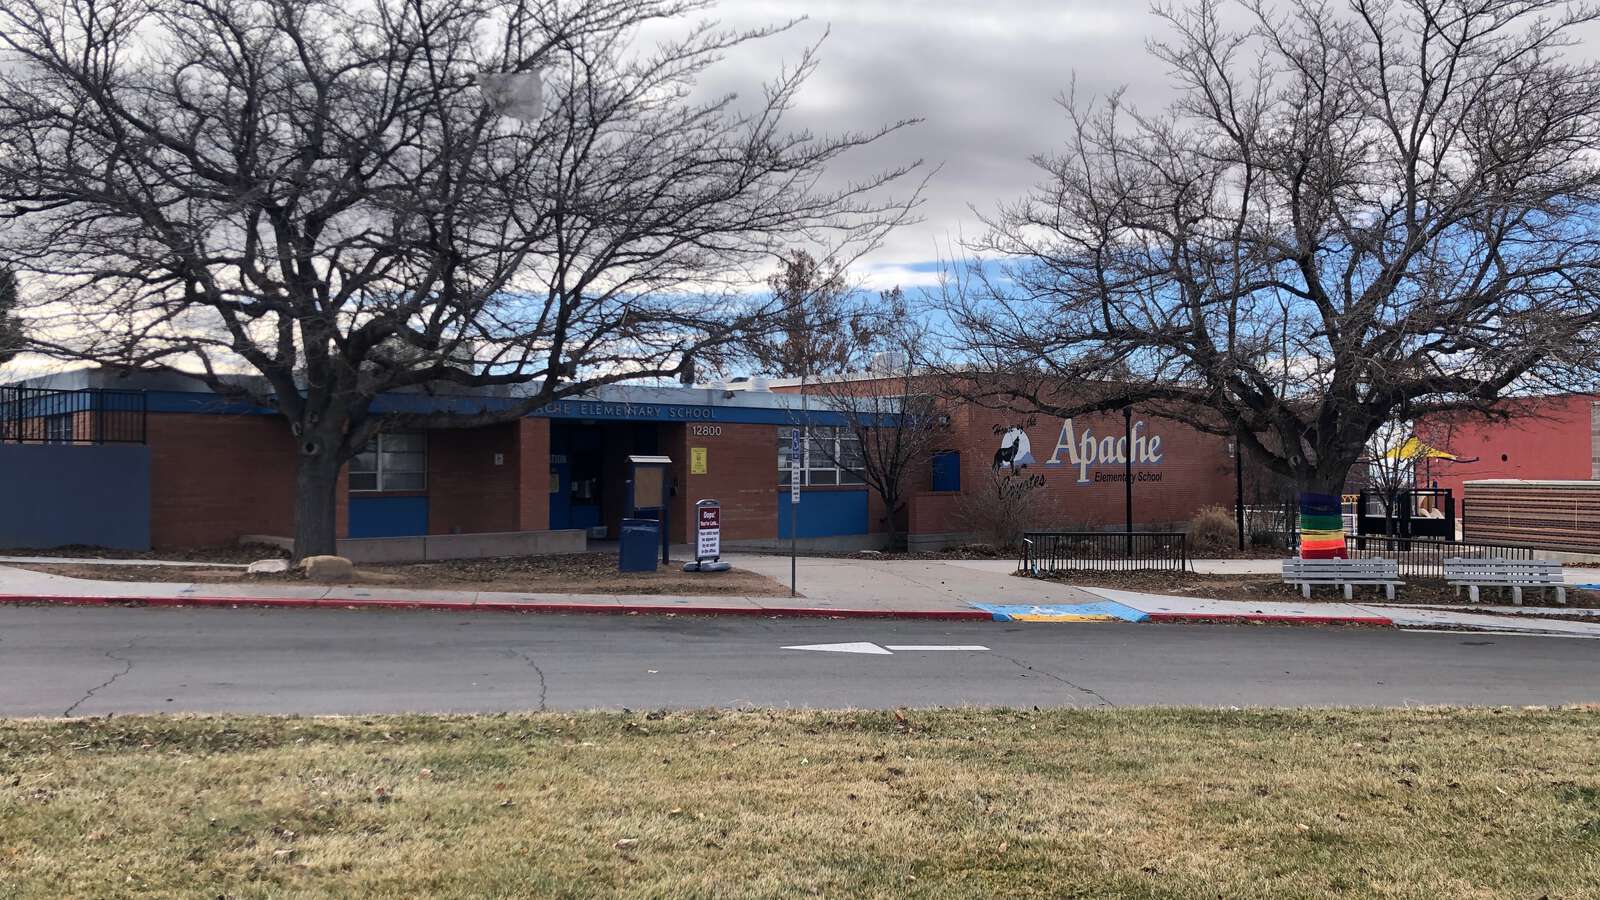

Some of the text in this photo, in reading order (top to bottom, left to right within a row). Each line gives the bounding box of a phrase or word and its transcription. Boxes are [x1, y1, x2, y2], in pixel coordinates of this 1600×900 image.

[581, 403, 661, 417] ELEMENTARY
[670, 407, 716, 418] SCHOOL
[692, 426, 721, 436] 12800
[1045, 418, 1163, 483] Apache
[1138, 471, 1163, 482] School
